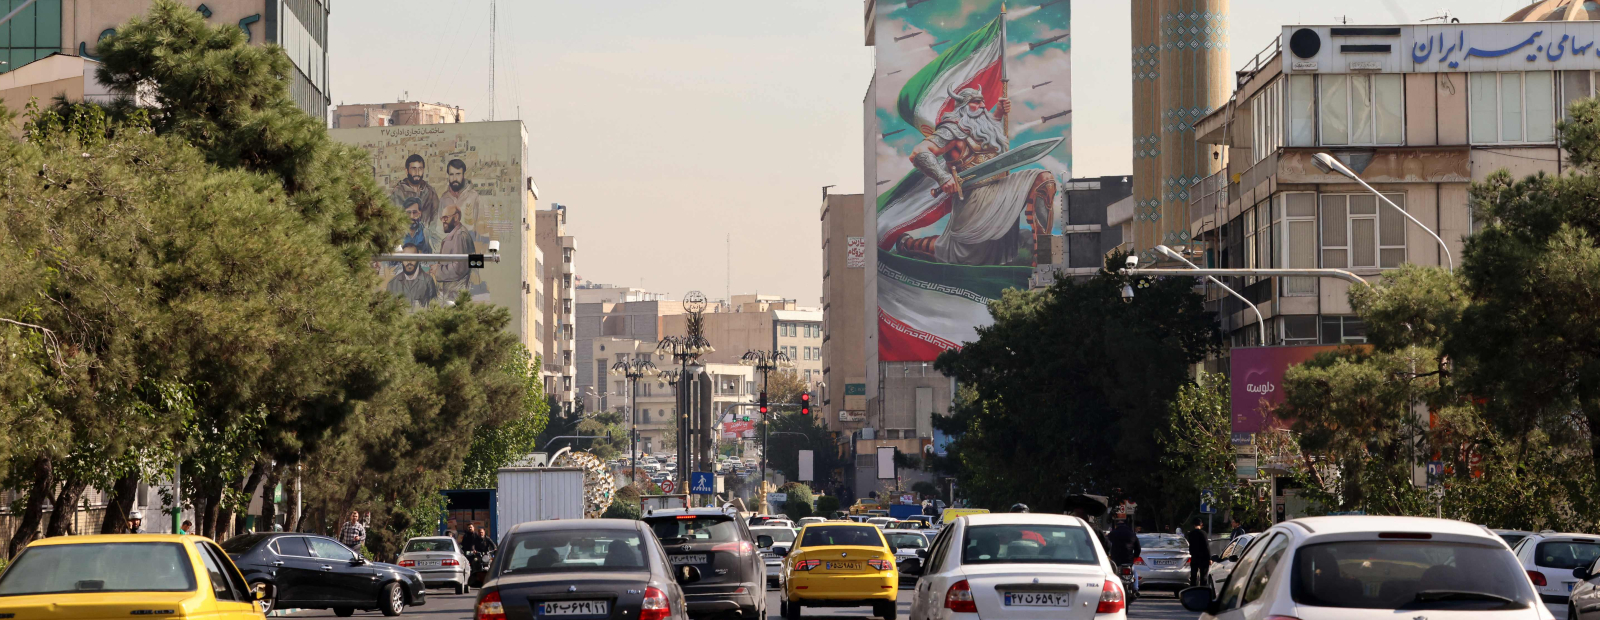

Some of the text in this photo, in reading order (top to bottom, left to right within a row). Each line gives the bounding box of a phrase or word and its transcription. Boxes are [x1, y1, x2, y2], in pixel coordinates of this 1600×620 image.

[1411, 30, 1594, 69] سهامی بیمه ایران
[390, 129, 405, 138] اداری
[405, 128, 421, 137] تجاری
[421, 127, 445, 137] ساختمان
[1246, 382, 1275, 395] دلوسه
